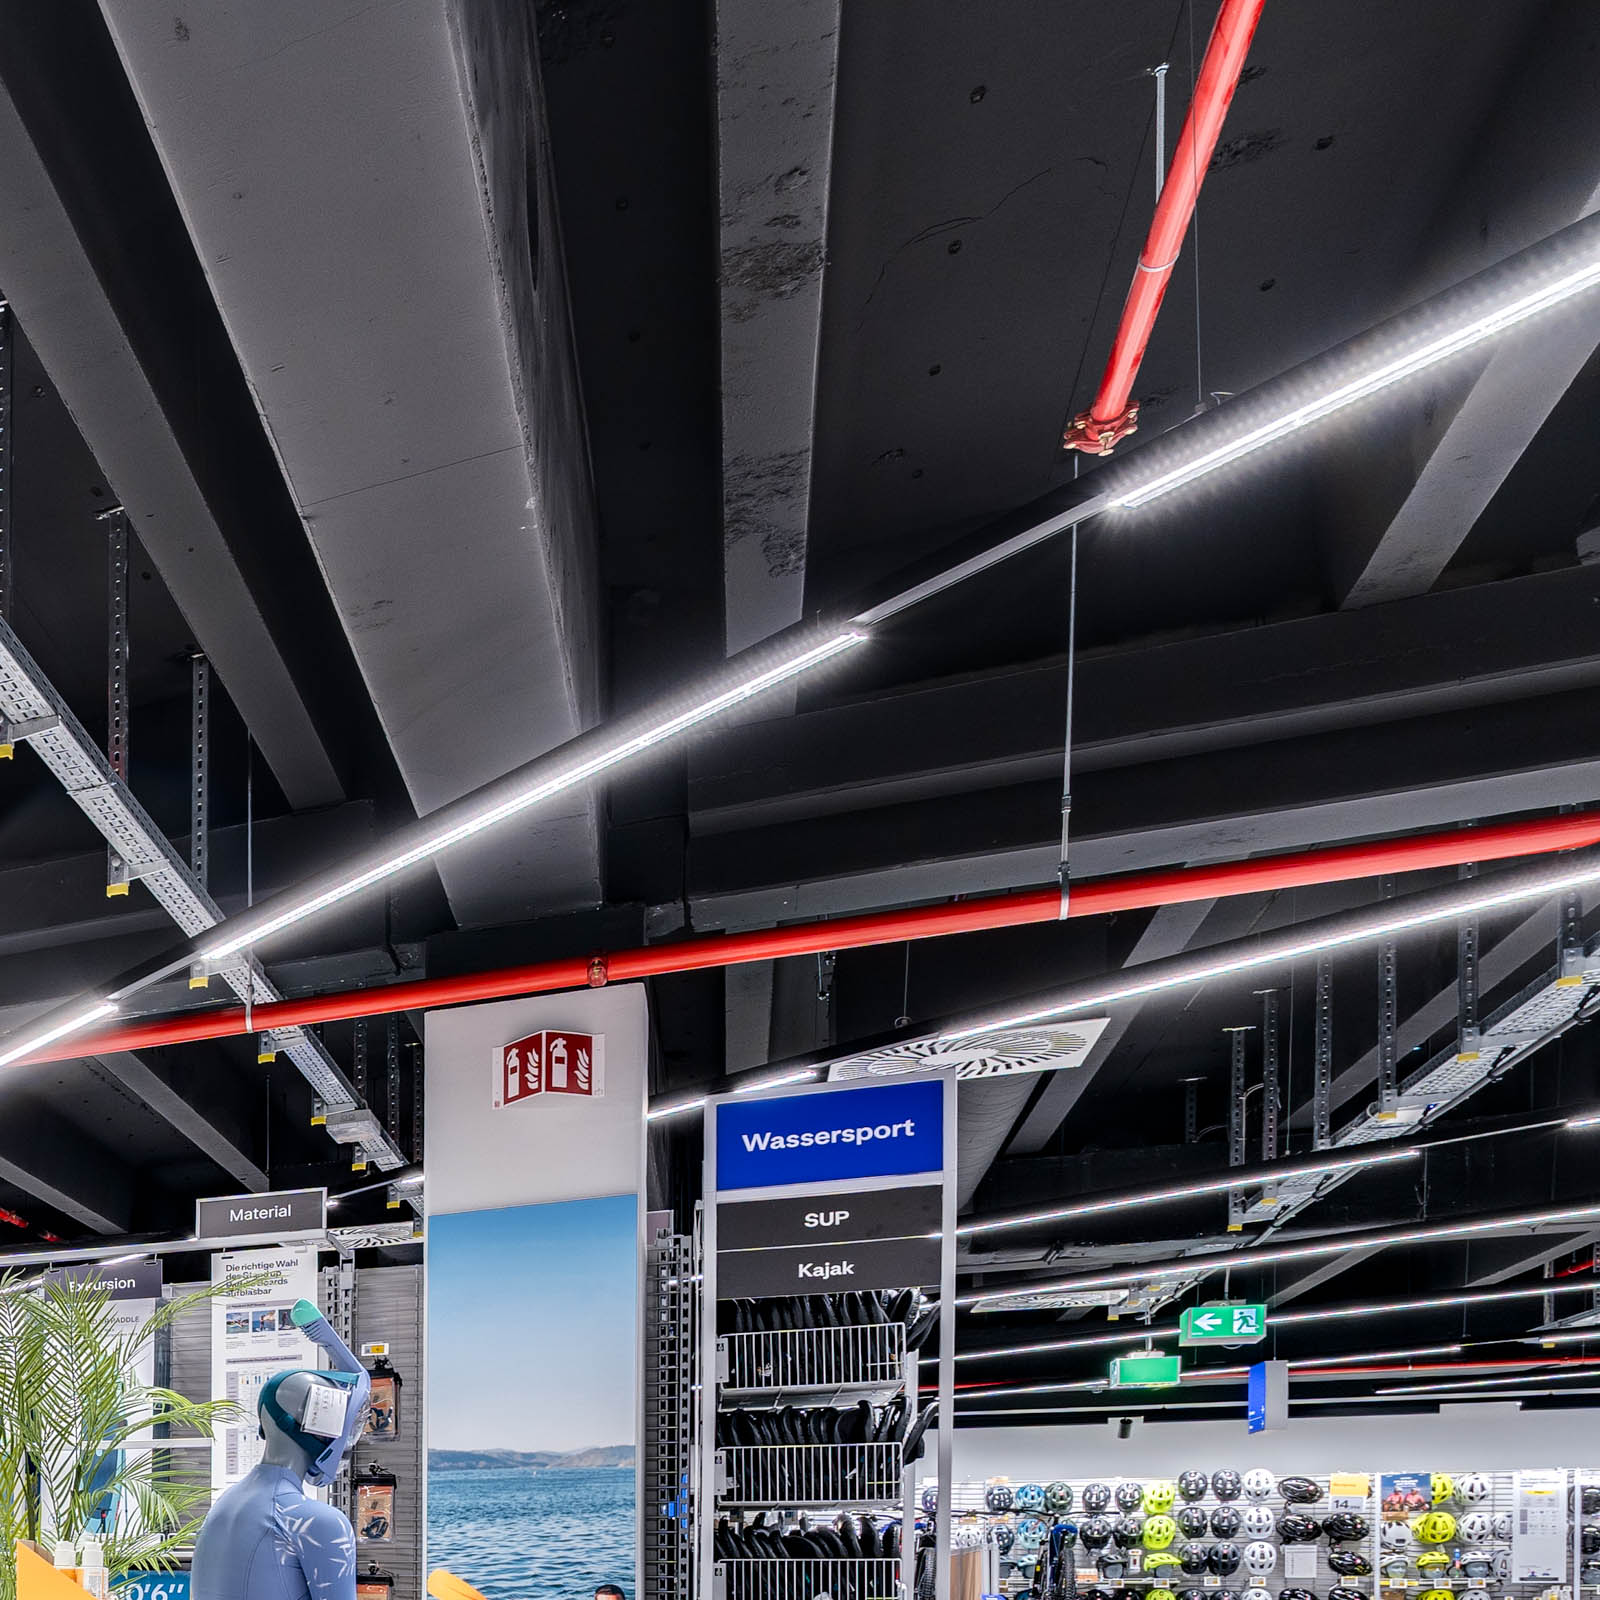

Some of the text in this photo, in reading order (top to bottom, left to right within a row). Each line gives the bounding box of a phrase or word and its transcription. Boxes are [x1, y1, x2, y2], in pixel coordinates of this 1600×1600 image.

[741, 1118, 915, 1152] Wassersport
[229, 1204, 292, 1222] Material
[804, 1210, 850, 1228] SUP
[226, 1259, 299, 1272] Die richtige Wahl
[798, 1261, 855, 1279] Kajak
